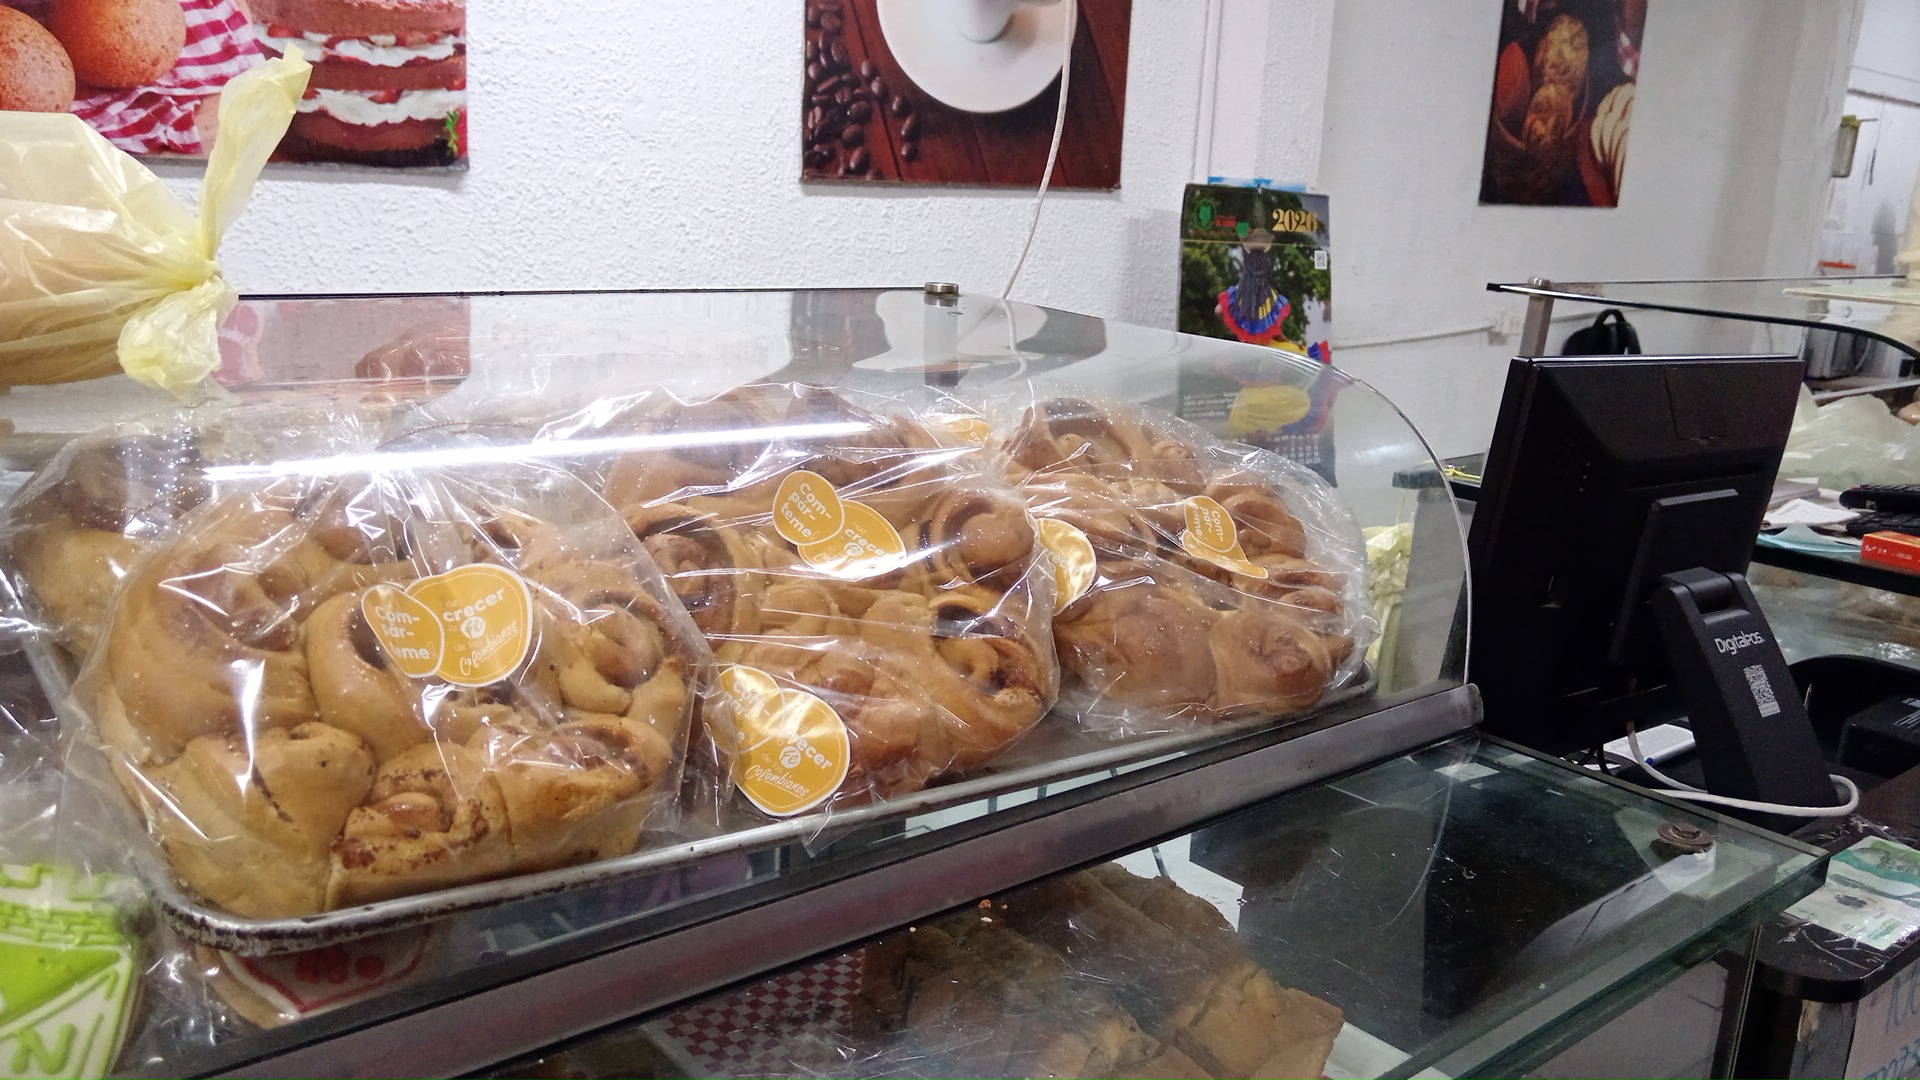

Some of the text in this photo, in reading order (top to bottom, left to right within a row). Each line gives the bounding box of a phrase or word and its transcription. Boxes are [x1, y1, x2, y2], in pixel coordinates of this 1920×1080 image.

[1272, 208, 1319, 233] 2026
[800, 482, 832, 519] Com-
[844, 528, 890, 558] crece
[1211, 510, 1224, 542] Com-
[374, 605, 421, 625] Com-
[442, 587, 505, 623] crecer
[459, 620, 519, 677] Colombianos
[744, 764, 811, 800] Colombianos
